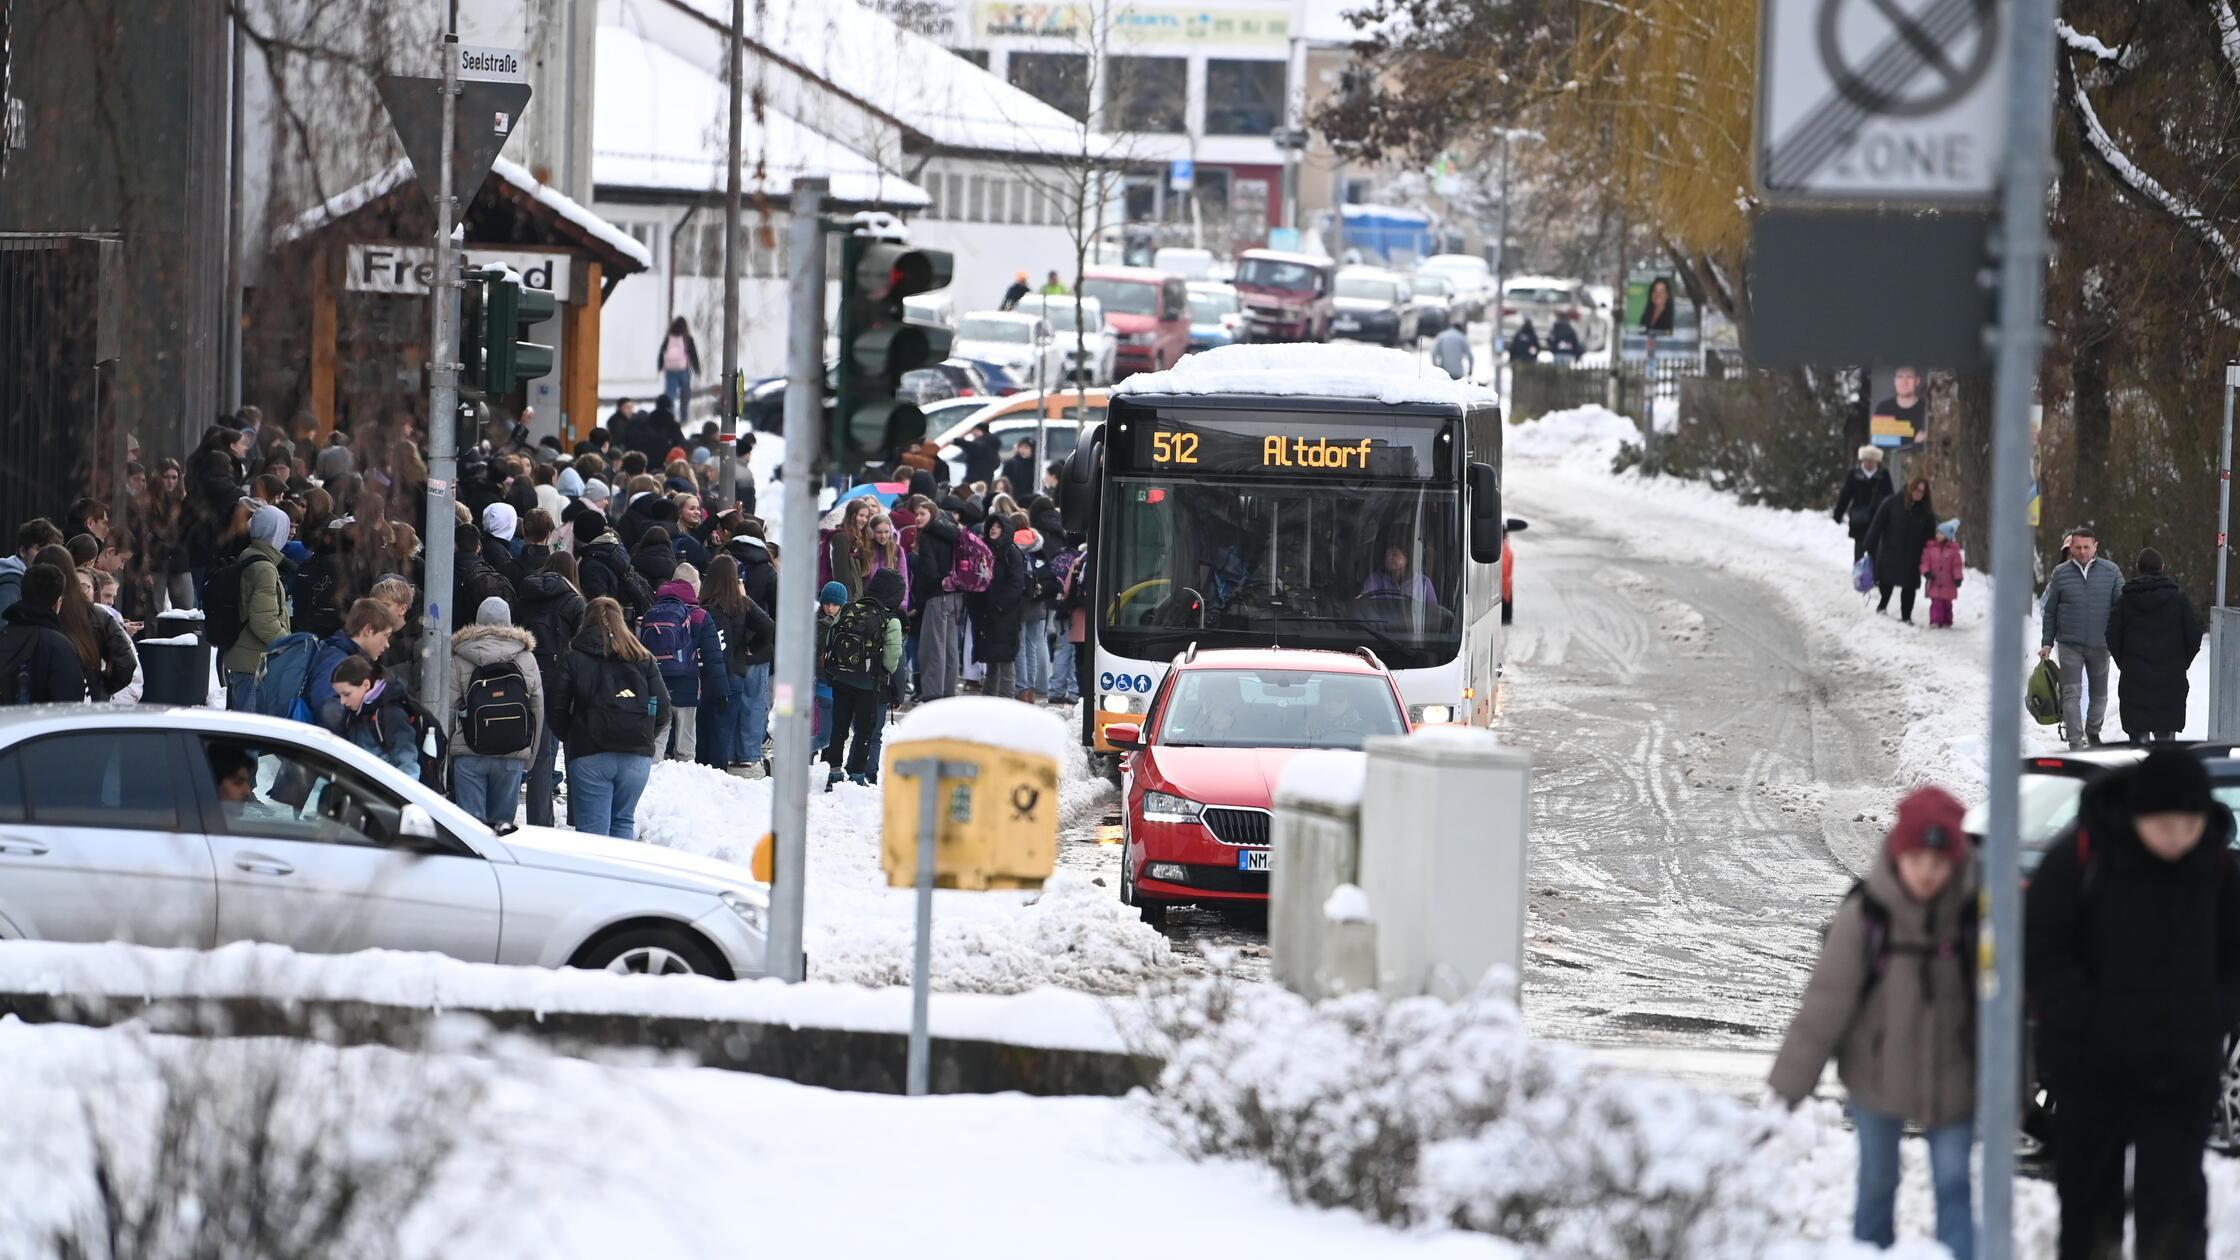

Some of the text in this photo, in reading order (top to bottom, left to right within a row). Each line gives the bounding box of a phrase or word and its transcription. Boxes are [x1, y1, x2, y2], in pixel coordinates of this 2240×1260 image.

[462, 50, 518, 74] Seelstraße
[362, 250, 553, 291] Fred
[1153, 431, 1372, 468] 512 Altdorf
[1249, 852, 1268, 869] NM
